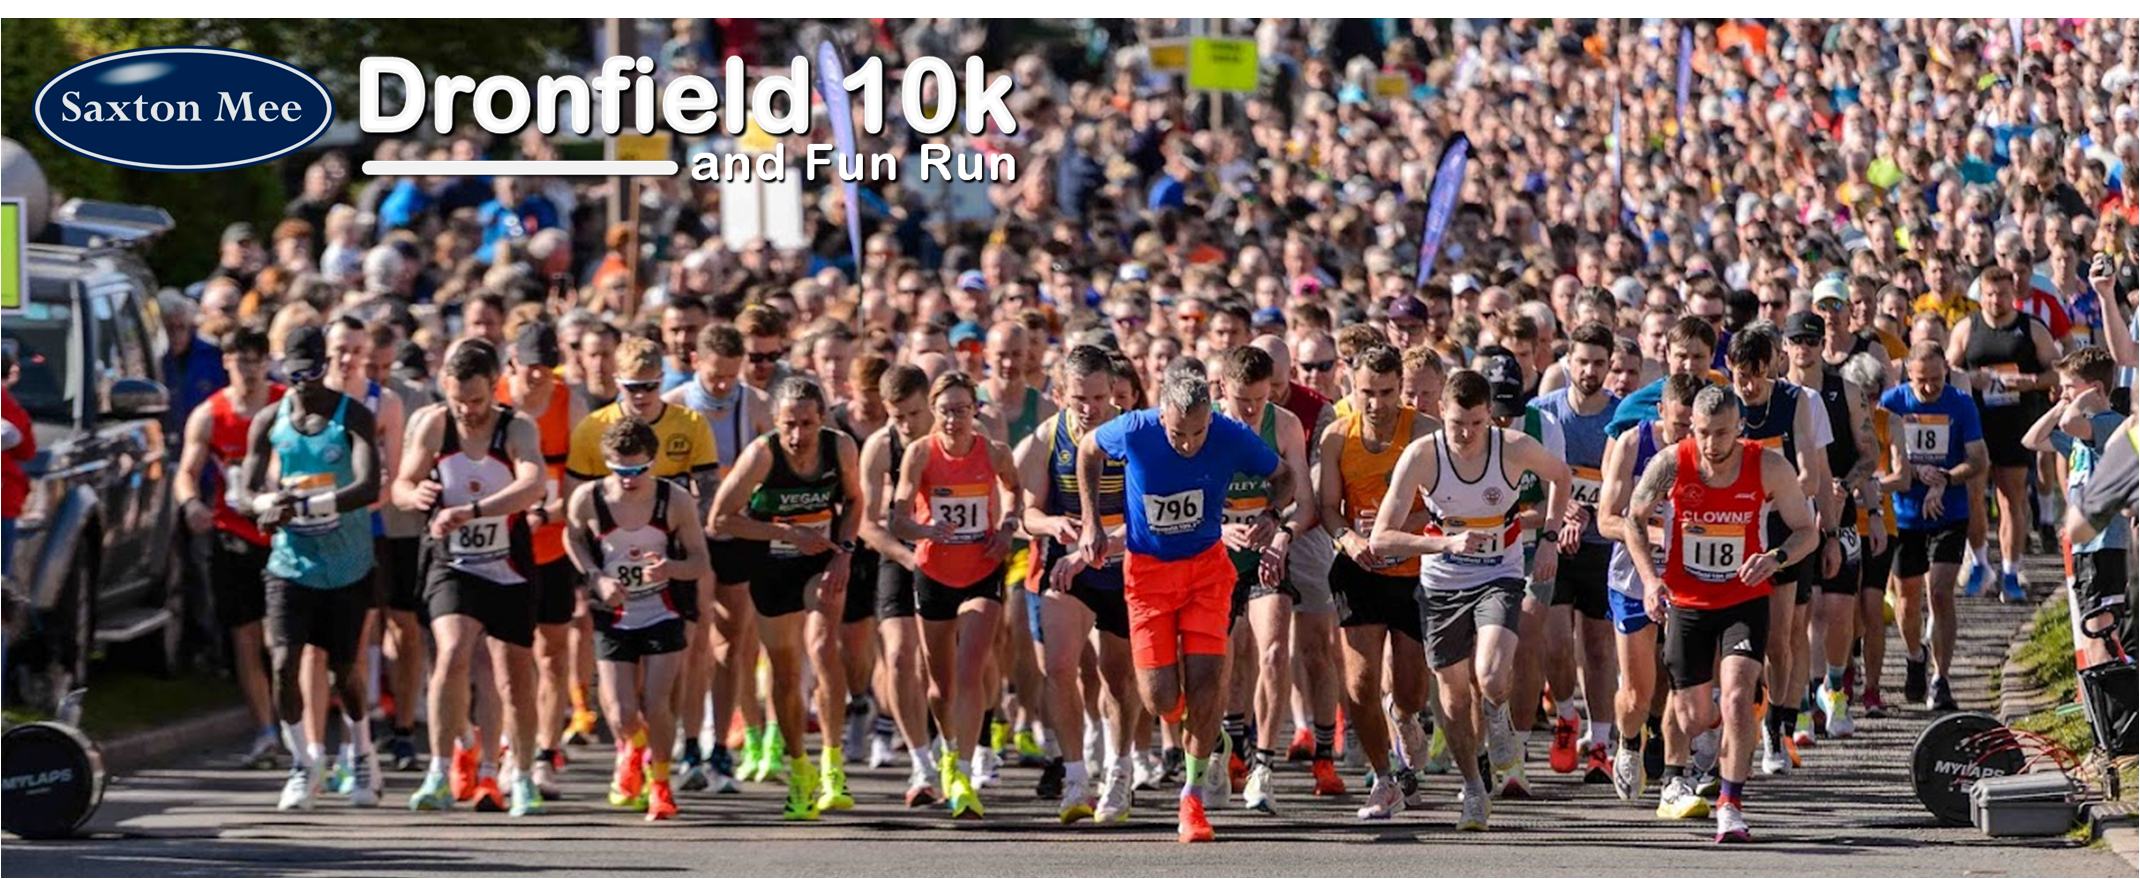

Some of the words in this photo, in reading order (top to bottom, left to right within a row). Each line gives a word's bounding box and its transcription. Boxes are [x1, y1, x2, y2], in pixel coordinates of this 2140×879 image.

[1917, 430, 1936, 450] 18
[780, 491, 831, 504] VEGAN
[1153, 495, 1197, 521] 796
[940, 503, 977, 528] 331
[1682, 510, 1754, 524] CLOWNE
[459, 523, 498, 548] 867
[1695, 541, 1734, 567] 118
[1934, 759, 2005, 778] MYLAPS
